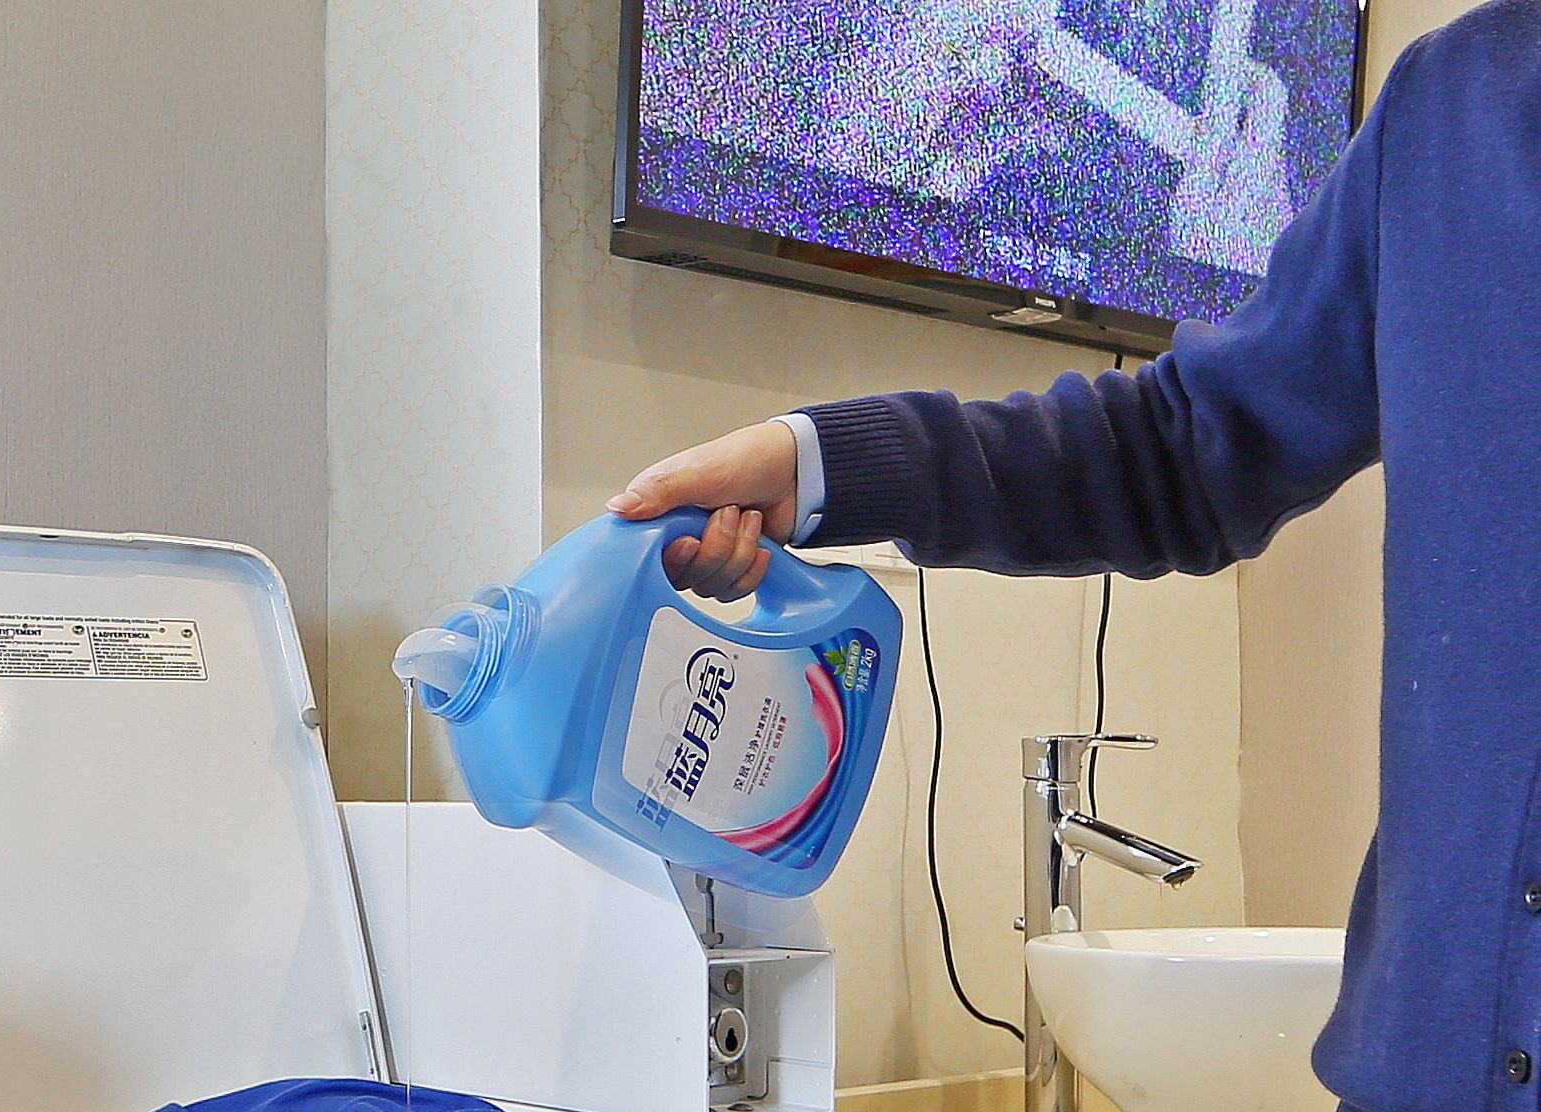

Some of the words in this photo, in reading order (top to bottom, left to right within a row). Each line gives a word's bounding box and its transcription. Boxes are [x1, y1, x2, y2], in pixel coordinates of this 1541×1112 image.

[99, 631, 150, 639] ADVERTENCIA
[664, 647, 736, 802] 蓝月亮
